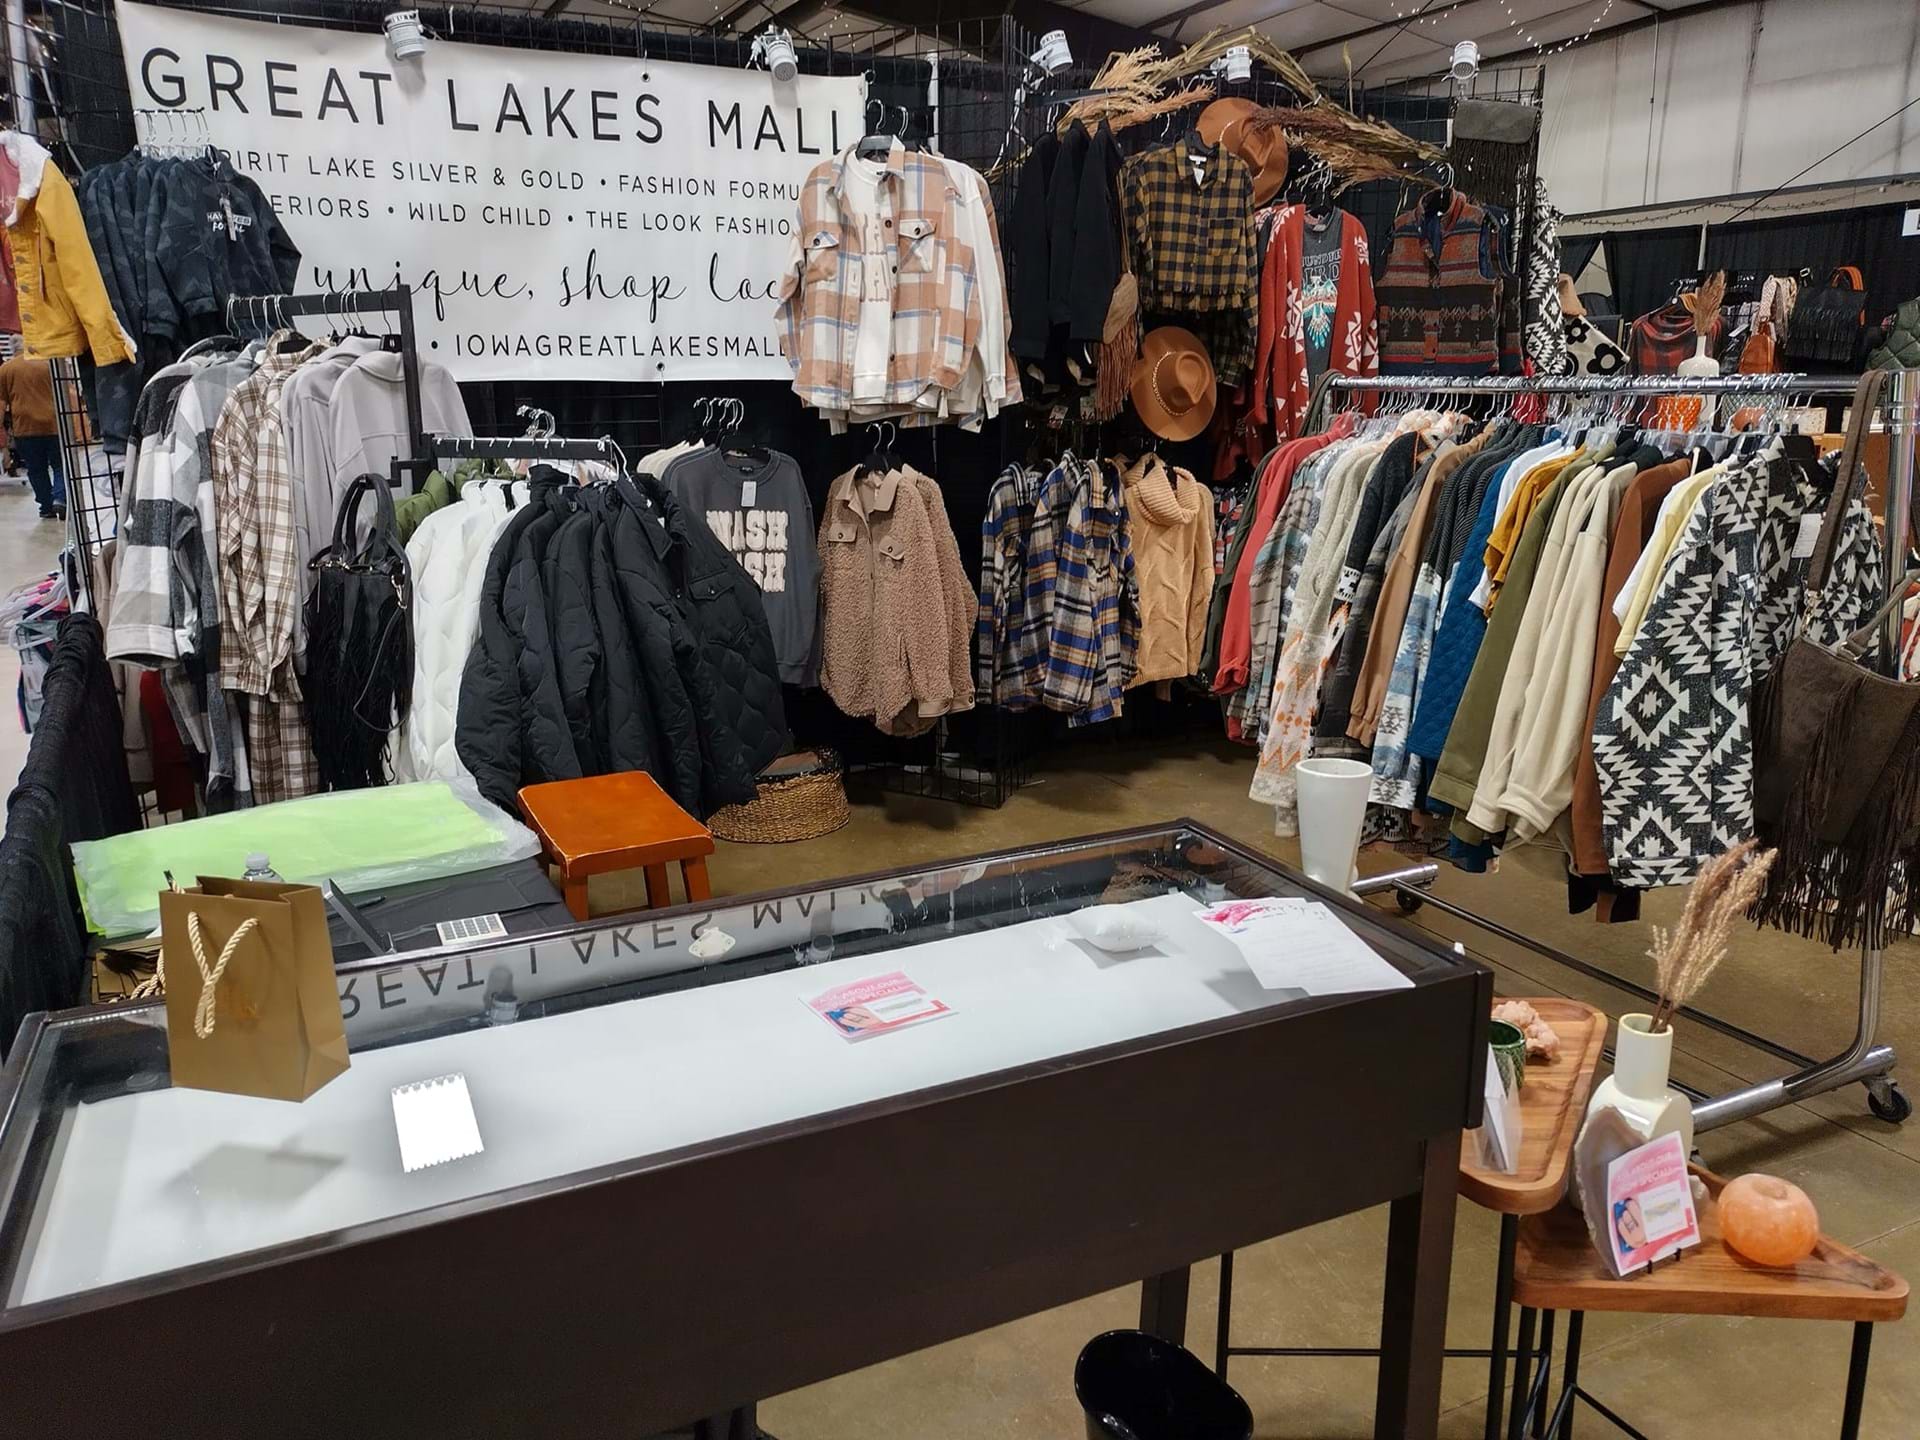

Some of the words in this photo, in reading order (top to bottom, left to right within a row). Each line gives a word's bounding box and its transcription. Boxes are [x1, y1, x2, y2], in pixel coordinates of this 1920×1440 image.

[141, 47, 392, 125] GREAT
[447, 78, 663, 145] LAKES
[308, 156, 376, 179] LAKE
[392, 161, 478, 185] SILVER
[493, 167, 505, 186] &
[521, 169, 584, 190] GOLD
[619, 175, 715, 197] FASHION
[408, 202, 466, 223] WILD
[482, 205, 551, 227] CHILD
[586, 210, 628, 230] THE
[643, 213, 701, 232] LOOK
[715, 216, 790, 236] FASHIO
[559, 248, 687, 324] shop
